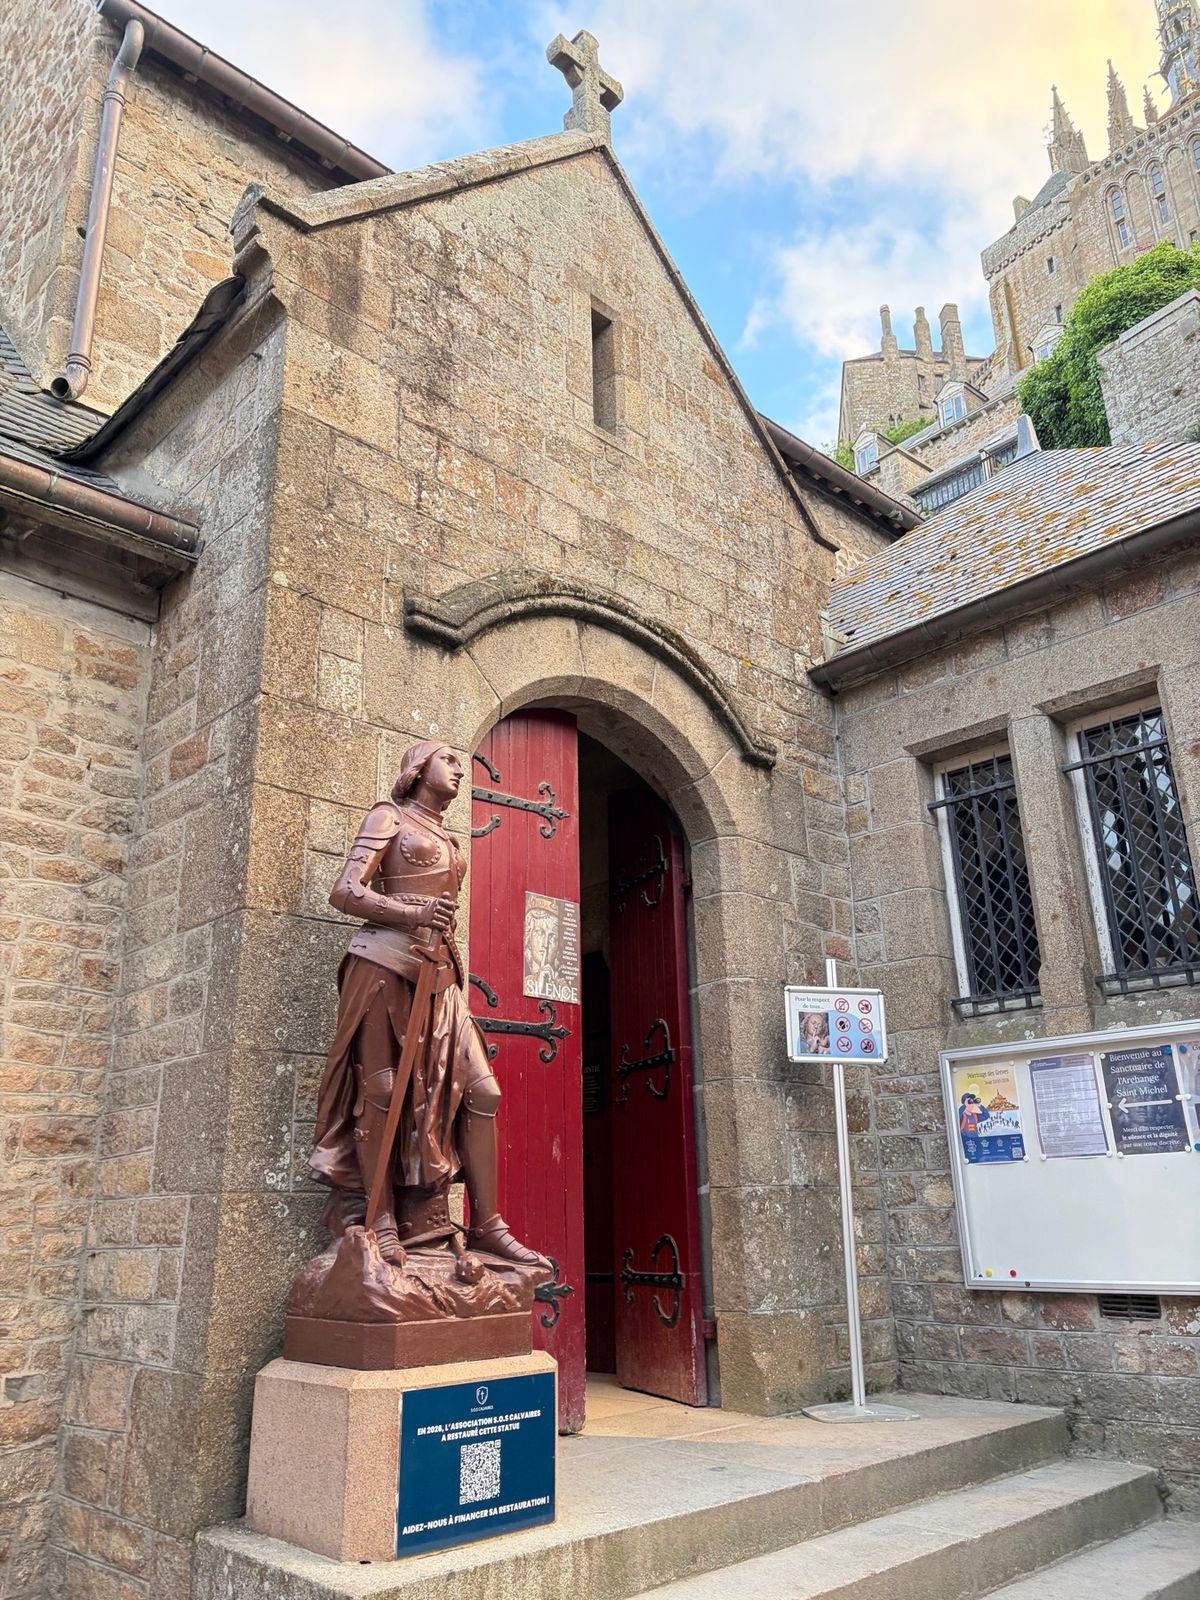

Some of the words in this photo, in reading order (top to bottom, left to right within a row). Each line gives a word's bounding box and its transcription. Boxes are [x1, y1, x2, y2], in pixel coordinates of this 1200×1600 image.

[526, 980, 578, 1002] SILENCE
[1109, 1051, 1150, 1062] Bienvenue
[1110, 1062, 1153, 1074] Sanctuaire
[1118, 1074, 1159, 1085] l'Archange
[1116, 1088, 1137, 1098] Saint
[1138, 1084, 1168, 1095] Michel
[1159, 1131, 1178, 1139] dignité
[445, 1417, 493, 1431] L'ASSOCIATION
[510, 1410, 541, 1421] CALVAIRES
[441, 1434, 447, 1442] A
[447, 1428, 478, 1441] RESTAURÉ
[479, 1426, 497, 1436] CETTE
[498, 1422, 520, 1433] STATUE
[402, 1518, 448, 1535] AIDEZ-NOUS
[448, 1514, 453, 1525] À
[454, 1509, 488, 1524] FINANCER
[489, 1507, 498, 1516] SA
[498, 1497, 546, 1514] RESTAURATION
